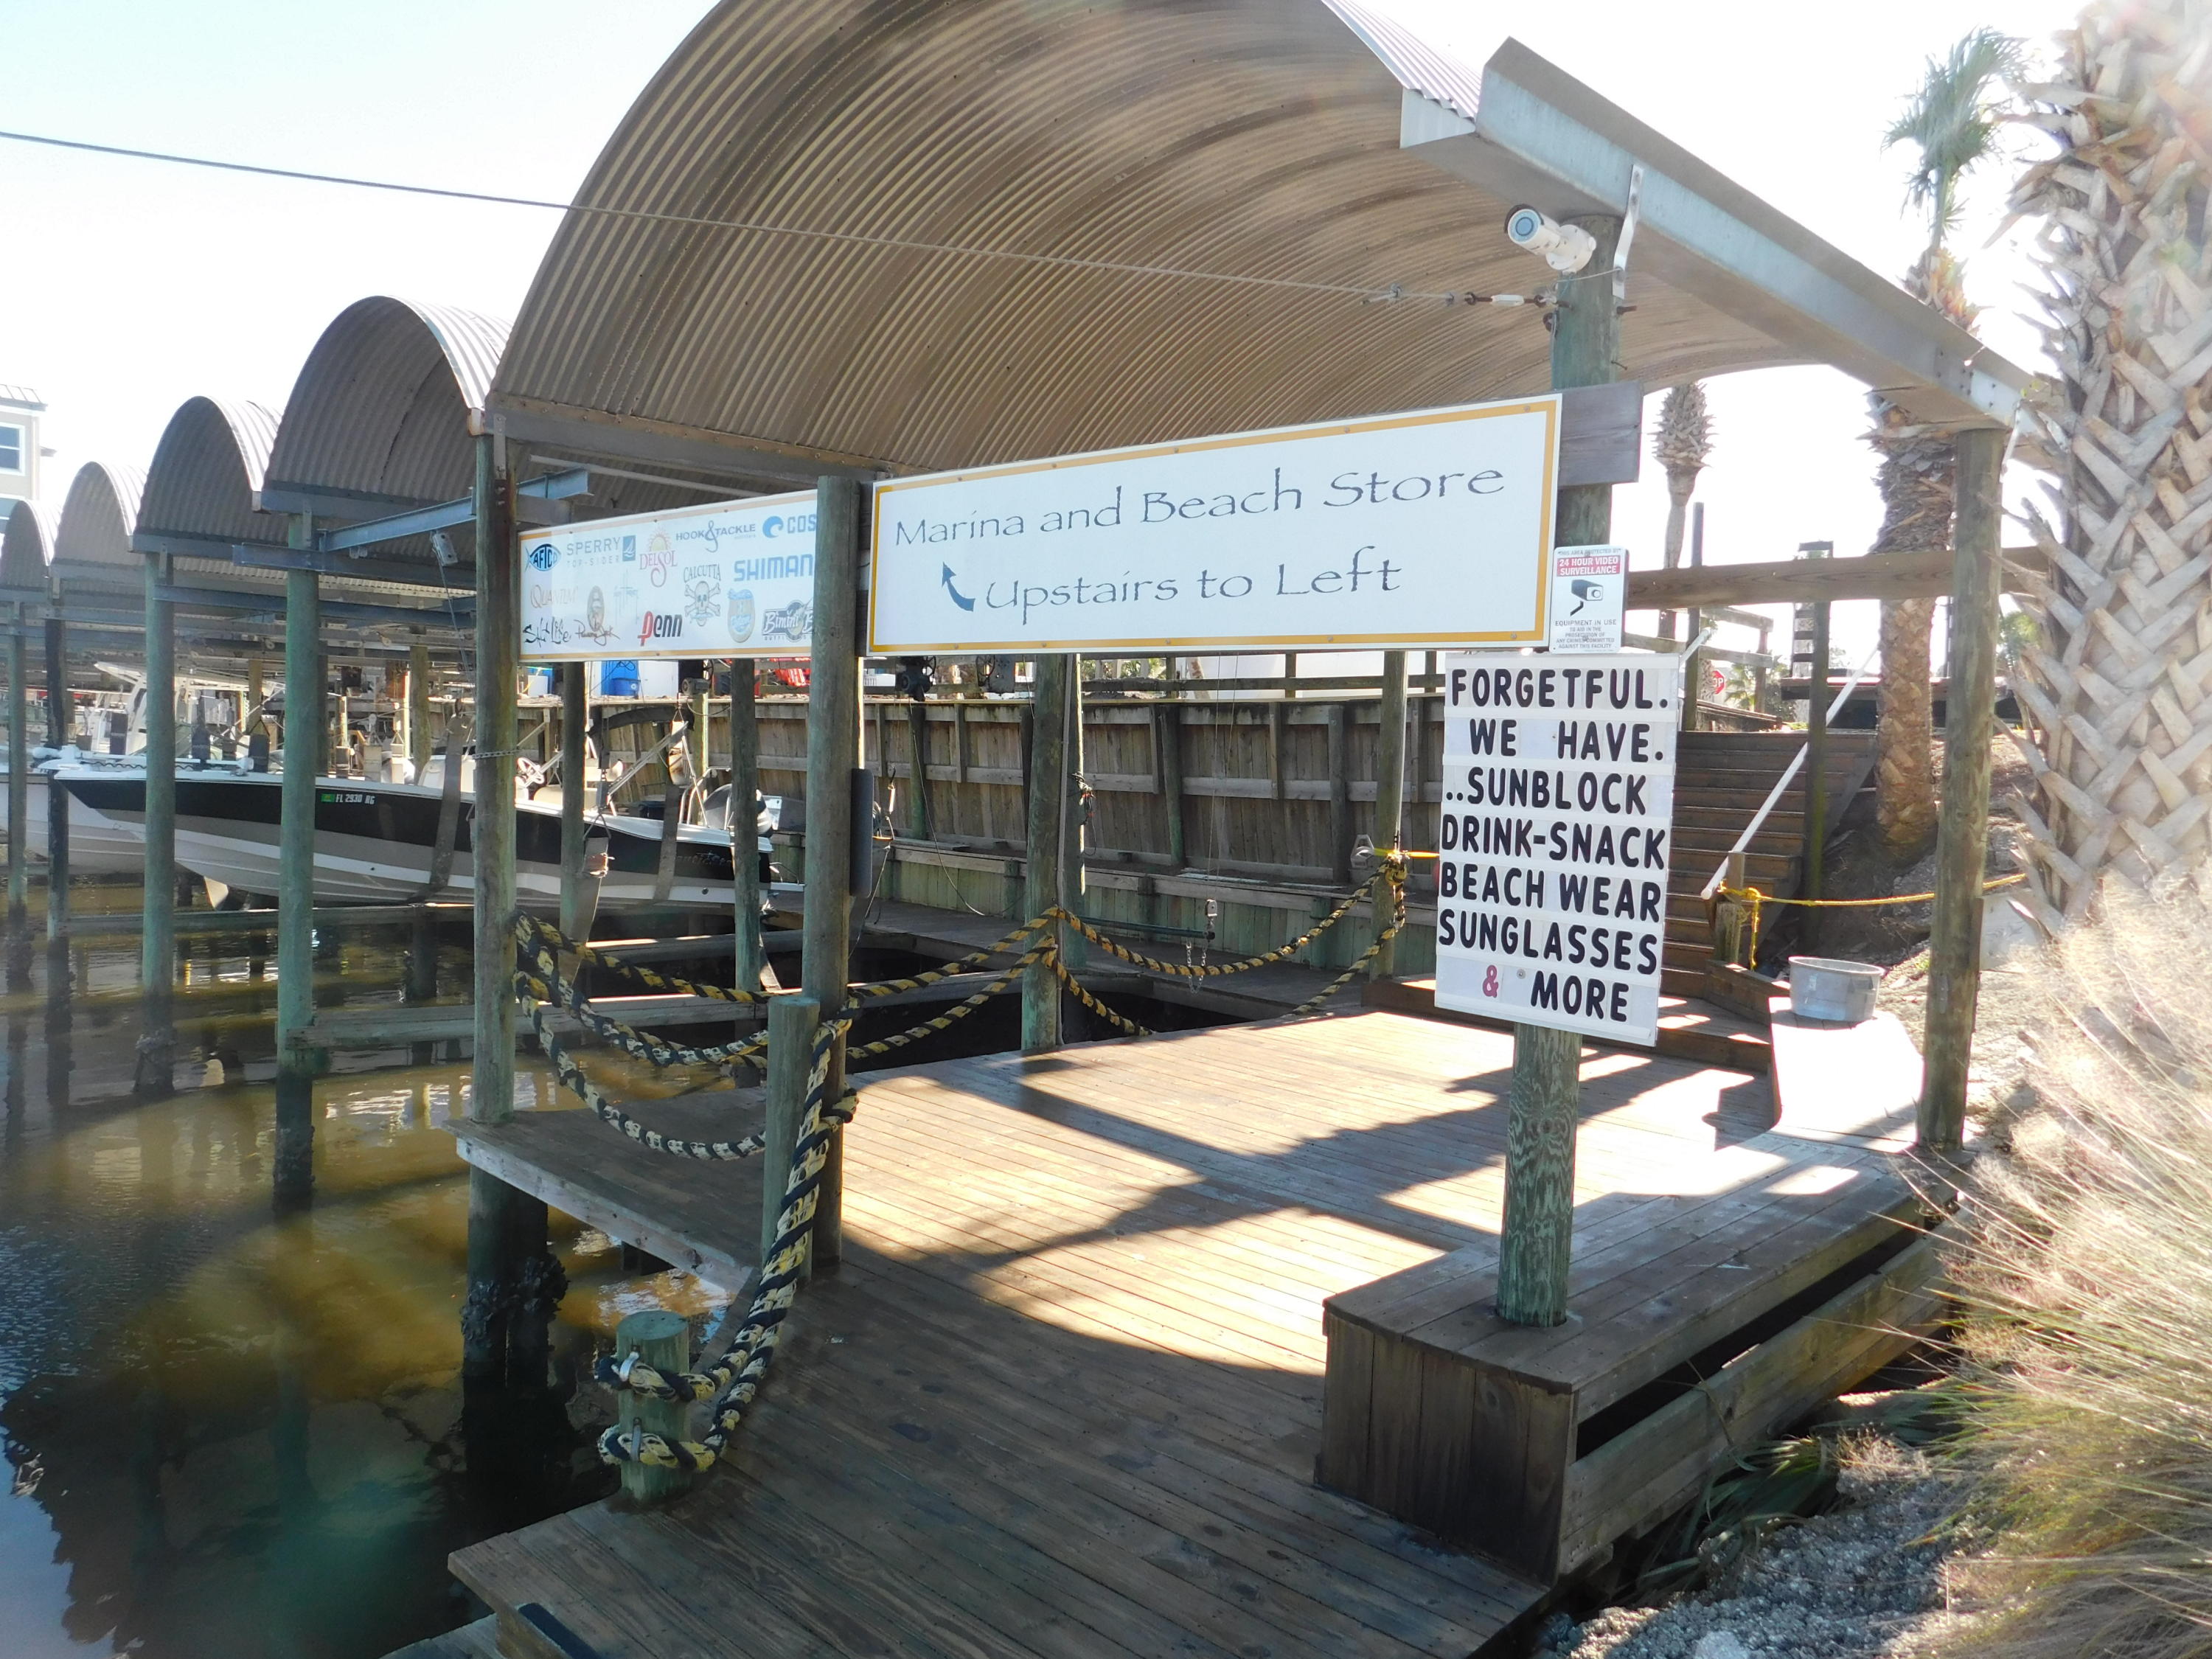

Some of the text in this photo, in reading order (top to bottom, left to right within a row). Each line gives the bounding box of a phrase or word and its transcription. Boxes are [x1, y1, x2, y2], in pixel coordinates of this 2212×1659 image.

[895, 467, 1505, 547] Marina and Beach Store
[566, 537, 621, 556] SPERRY
[1571, 557, 1593, 566] HOUR
[1595, 556, 1618, 565] VIDEO
[684, 564, 722, 582] CALCUTTA
[985, 546, 1402, 626] Upstairs to Left
[1560, 565, 1617, 575] SURVEILLANCE
[1450, 669, 1669, 709] FORGETFUL.
[1470, 718, 1663, 763] WE HAVE.
[335, 793, 344, 803] FL
[1441, 813, 1666, 870] DRINK-SNACK
[1440, 861, 1662, 923] BEACH WEAR
[1439, 908, 1658, 975] SUNGLASSES
[1482, 964, 1630, 1023] & MORE
